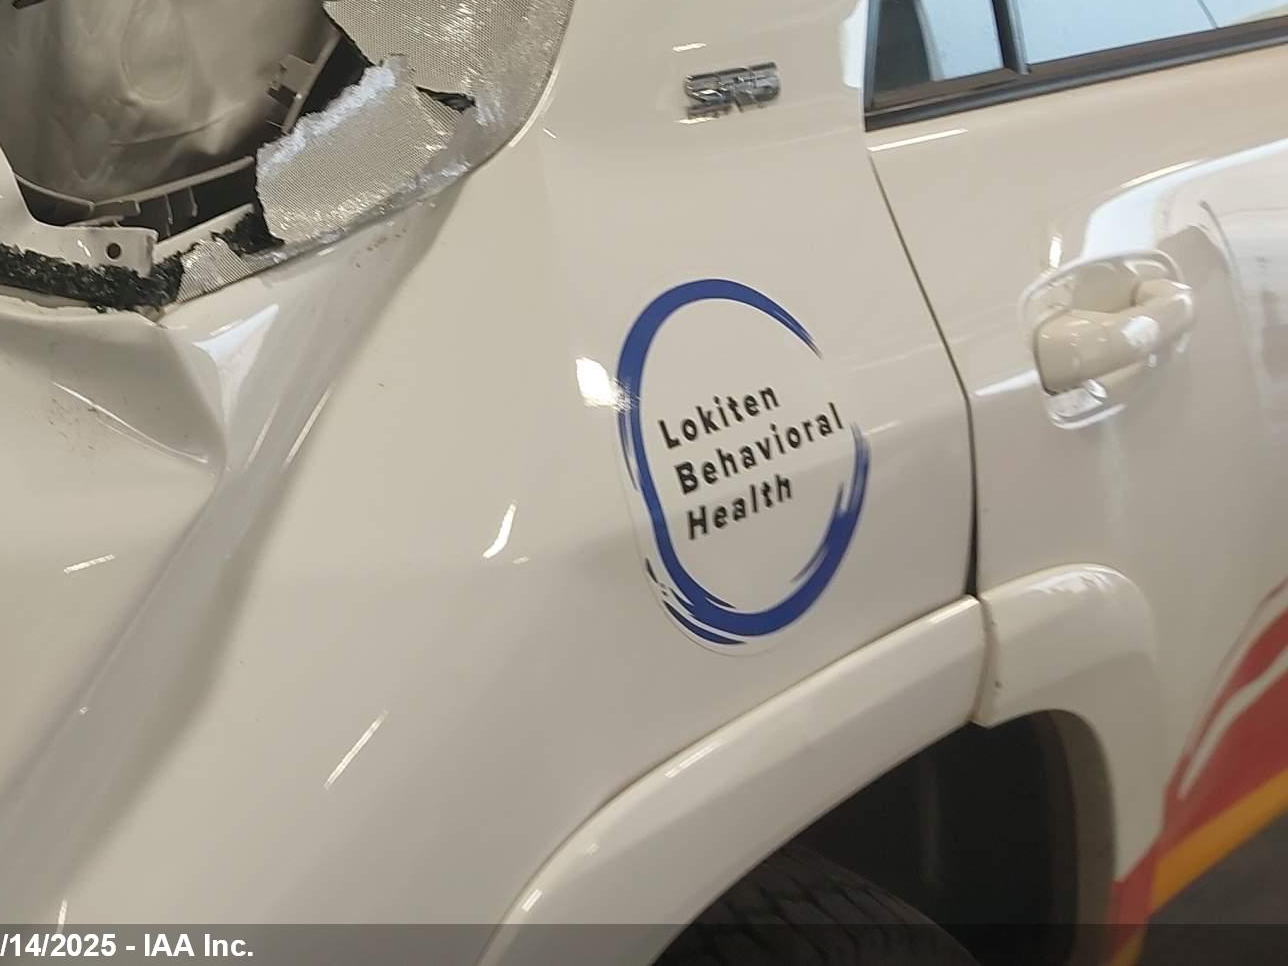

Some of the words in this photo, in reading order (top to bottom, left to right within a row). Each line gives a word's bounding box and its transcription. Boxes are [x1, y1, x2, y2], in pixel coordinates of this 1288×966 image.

[658, 386, 780, 450] Lokiten
[674, 402, 844, 495] Behavioral
[686, 474, 793, 540] Health
